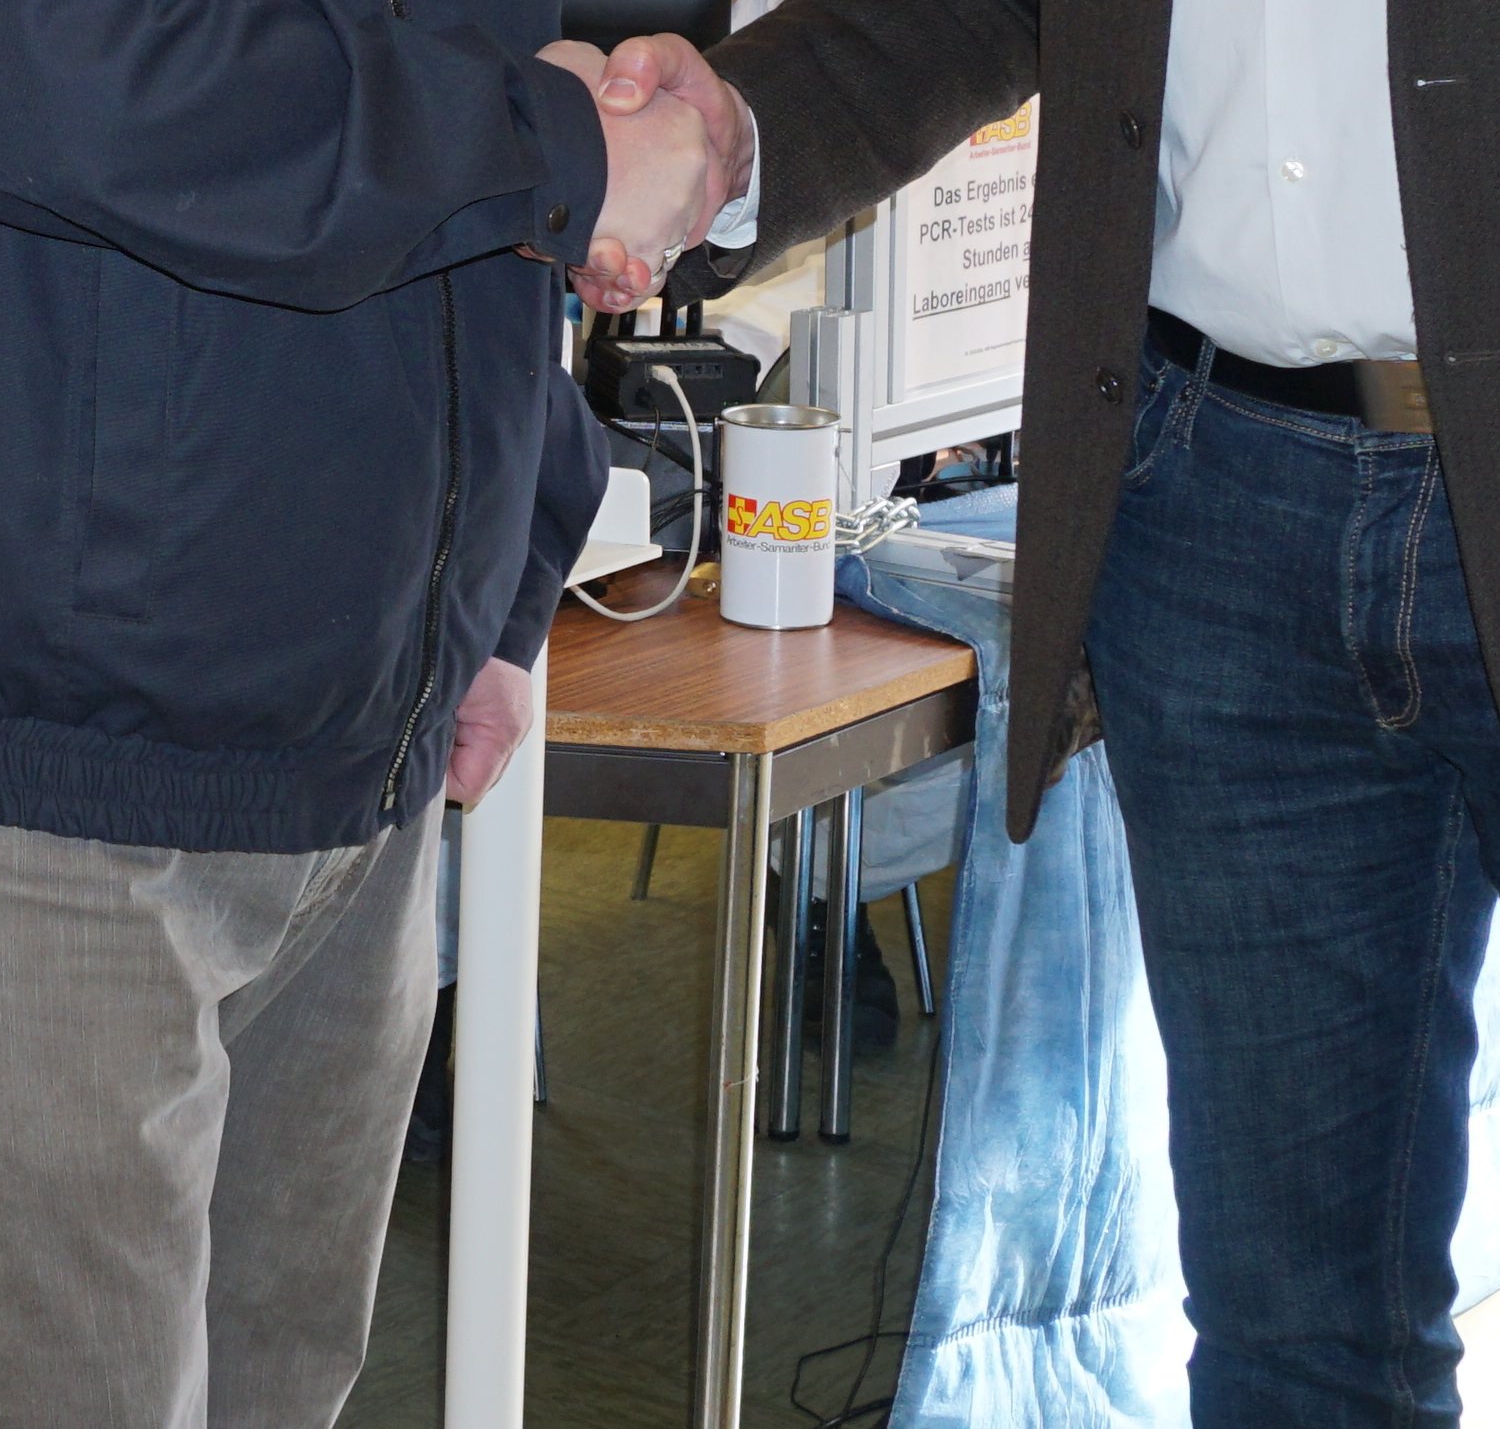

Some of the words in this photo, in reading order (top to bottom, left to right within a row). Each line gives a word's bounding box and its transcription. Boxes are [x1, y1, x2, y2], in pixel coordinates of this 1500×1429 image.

[934, 186, 961, 207] Das
[968, 171, 1027, 203] Ergebnis
[920, 211, 996, 245] PCR-Tests
[1000, 206, 1016, 229] ist
[963, 241, 1018, 269] Stunden
[913, 279, 1010, 315] Laboreingang
[746, 499, 832, 541] ASB
